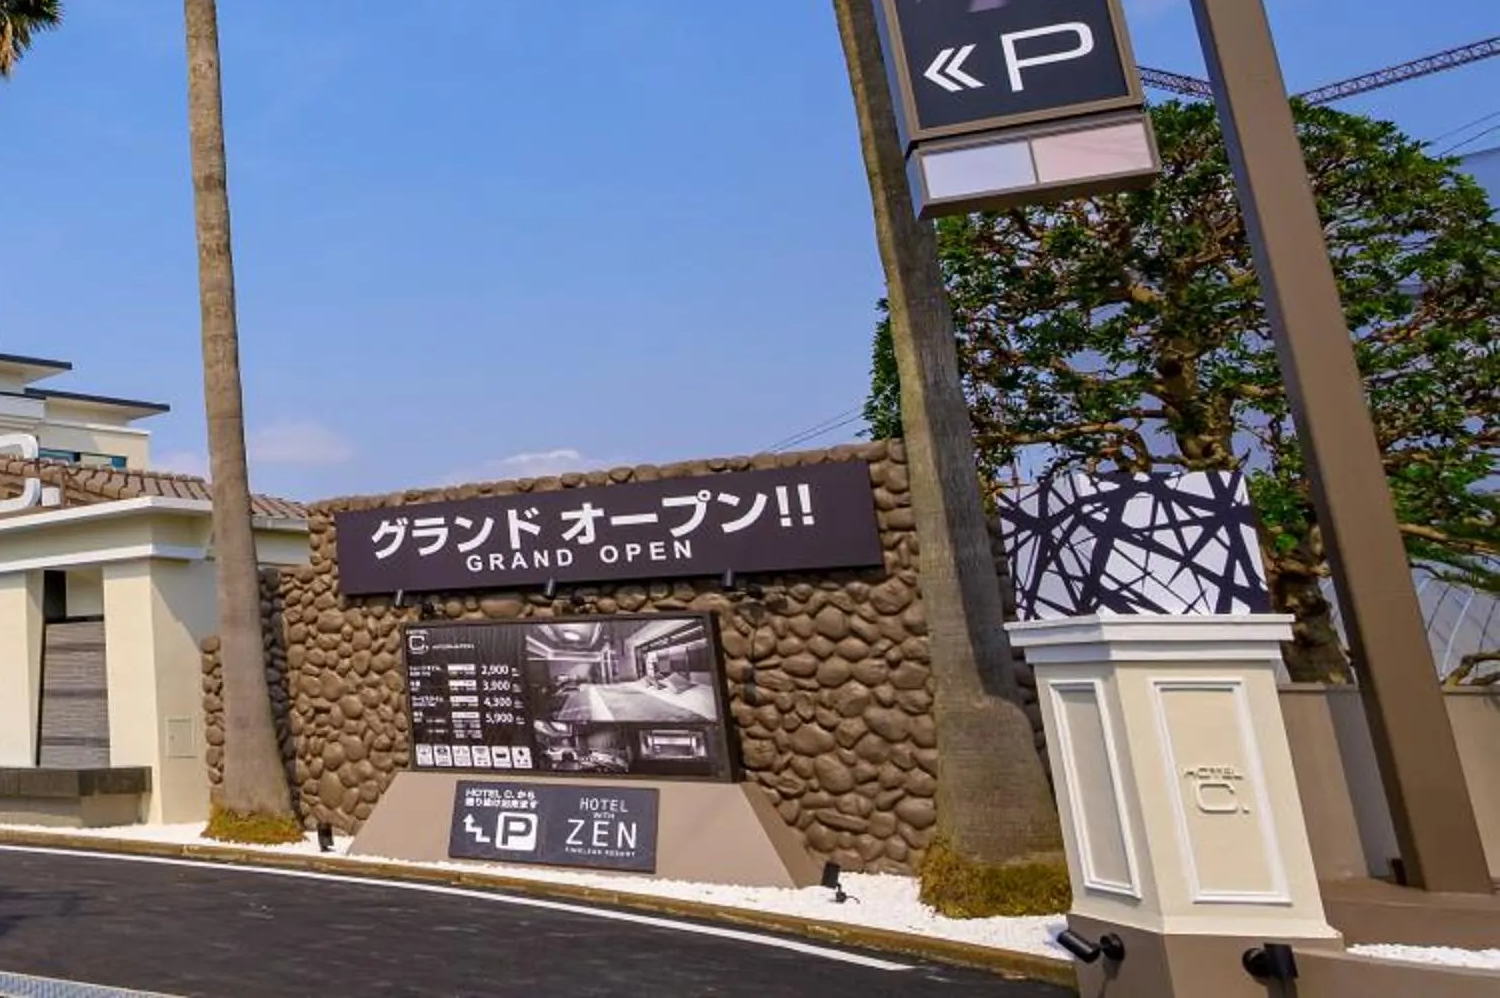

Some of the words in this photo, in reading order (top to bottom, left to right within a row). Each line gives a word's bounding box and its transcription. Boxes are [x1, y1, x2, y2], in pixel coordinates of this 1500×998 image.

[1001, 21, 1095, 92] P
[371, 506, 542, 560] グランド
[466, 547, 574, 573] GRAND
[600, 539, 693, 564] OPEN
[580, 797, 629, 813] HOTEL
[500, 815, 534, 848] P
[565, 818, 637, 849] ZEN
